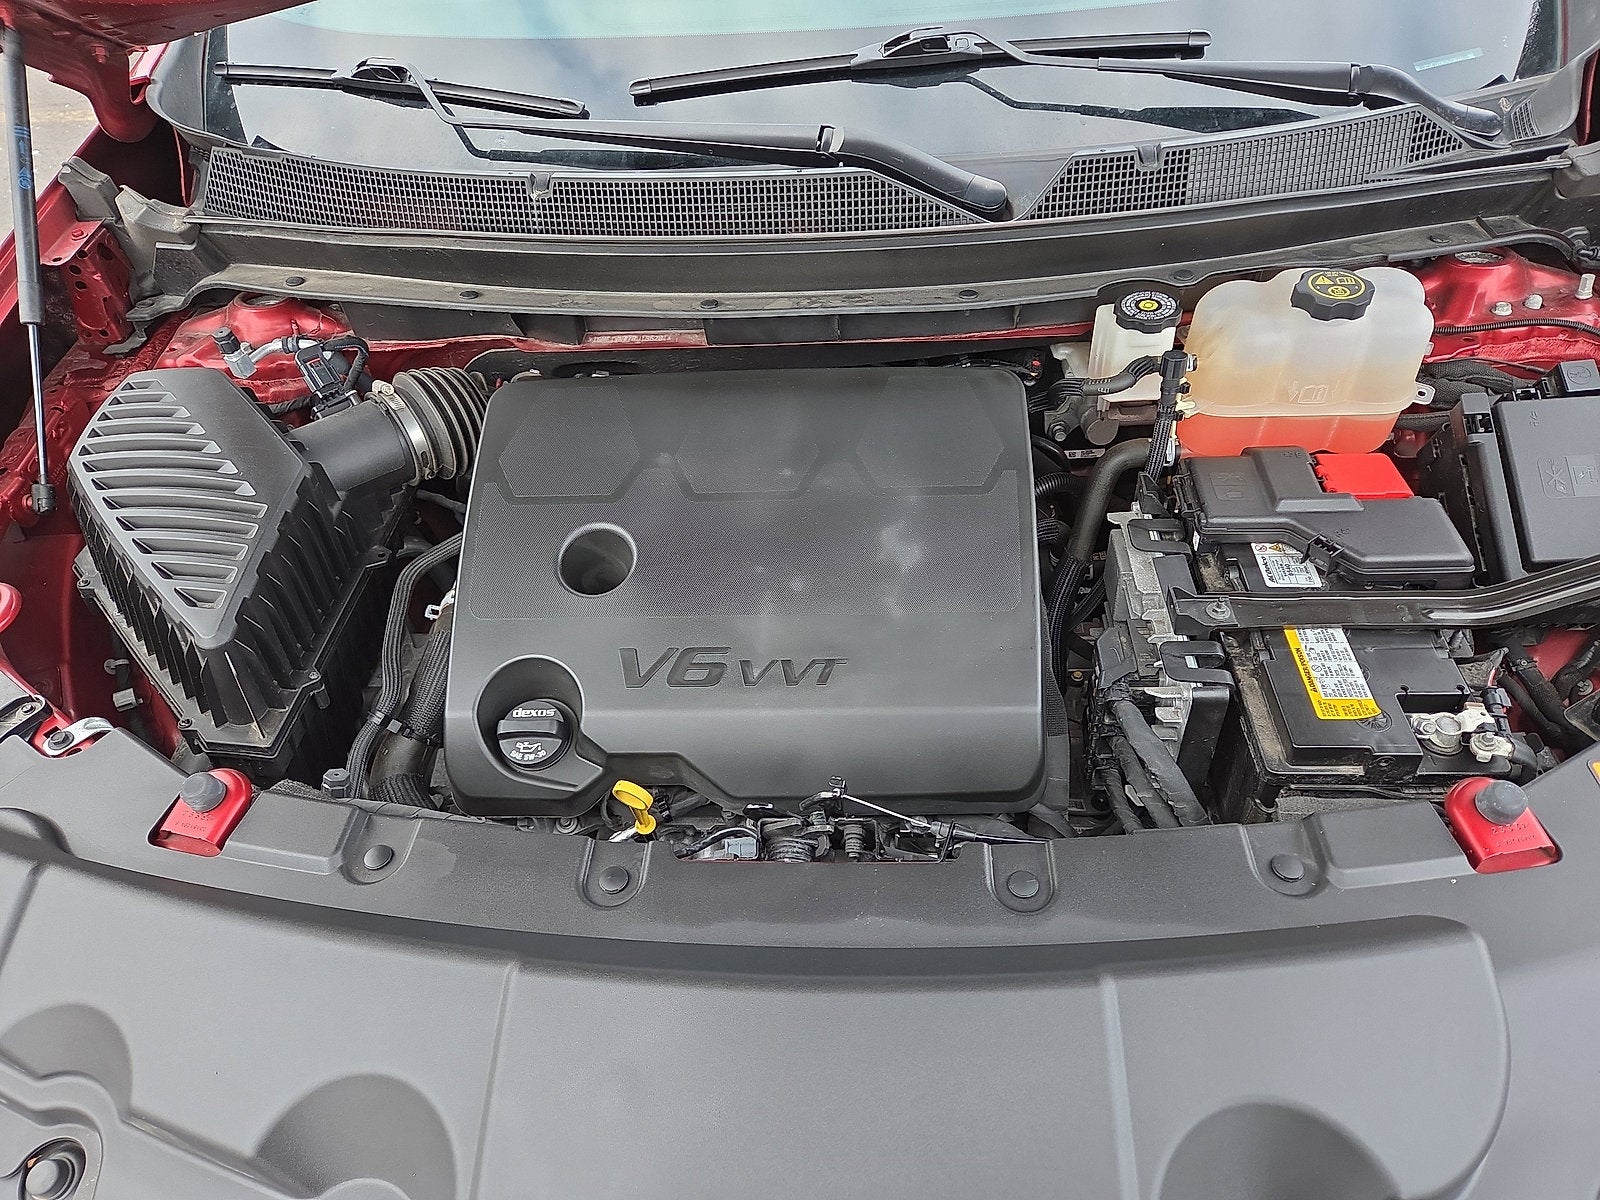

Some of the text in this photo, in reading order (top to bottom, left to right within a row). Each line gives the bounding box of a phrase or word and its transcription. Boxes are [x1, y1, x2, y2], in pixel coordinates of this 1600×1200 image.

[619, 647, 848, 689] V6 VVT
[512, 707, 557, 717] dexos
[510, 749, 547, 761] SAE 5W-30
